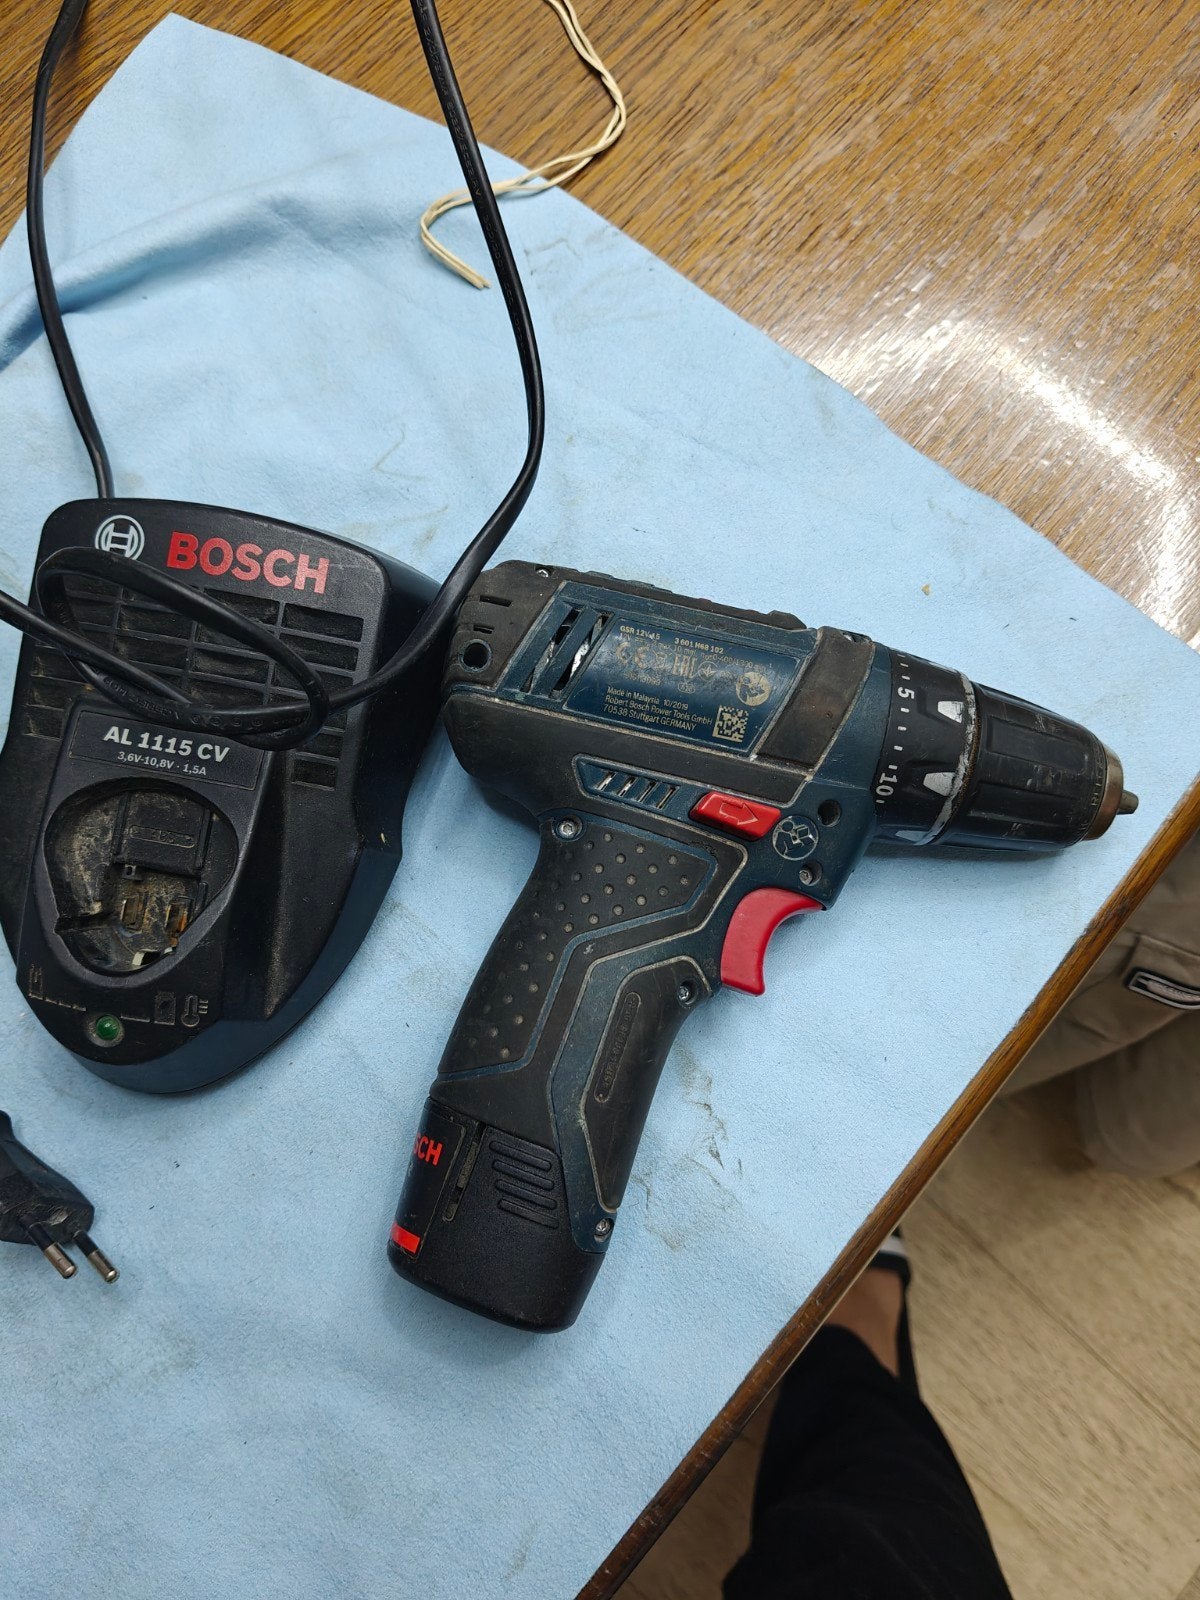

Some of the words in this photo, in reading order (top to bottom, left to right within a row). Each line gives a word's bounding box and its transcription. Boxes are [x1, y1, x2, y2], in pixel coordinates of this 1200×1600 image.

[167, 531, 330, 594] BOSCH
[620, 625, 635, 634] GSR
[680, 639, 694, 647] 601
[710, 645, 724, 654] 102
[606, 686, 625, 696] Made
[625, 689, 632, 697] in
[633, 691, 660, 705] Malaysia
[898, 686, 914, 700] 5
[603, 704, 628, 716] 70538
[629, 709, 660, 724] Stuttgart
[660, 716, 697, 731] GERMANY
[605, 695, 629, 706] Robert
[629, 700, 649, 712] Bosch
[651, 704, 672, 716] Power
[673, 709, 690, 720] Tools
[691, 714, 712, 725] GmbH
[103, 725, 132, 746] AL
[138, 732, 194, 757] 1115
[197, 743, 230, 763] CV
[117, 751, 174, 769] 3,6V-10,8V
[182, 763, 207, 776] 1,5A
[875, 772, 898, 797] 10
